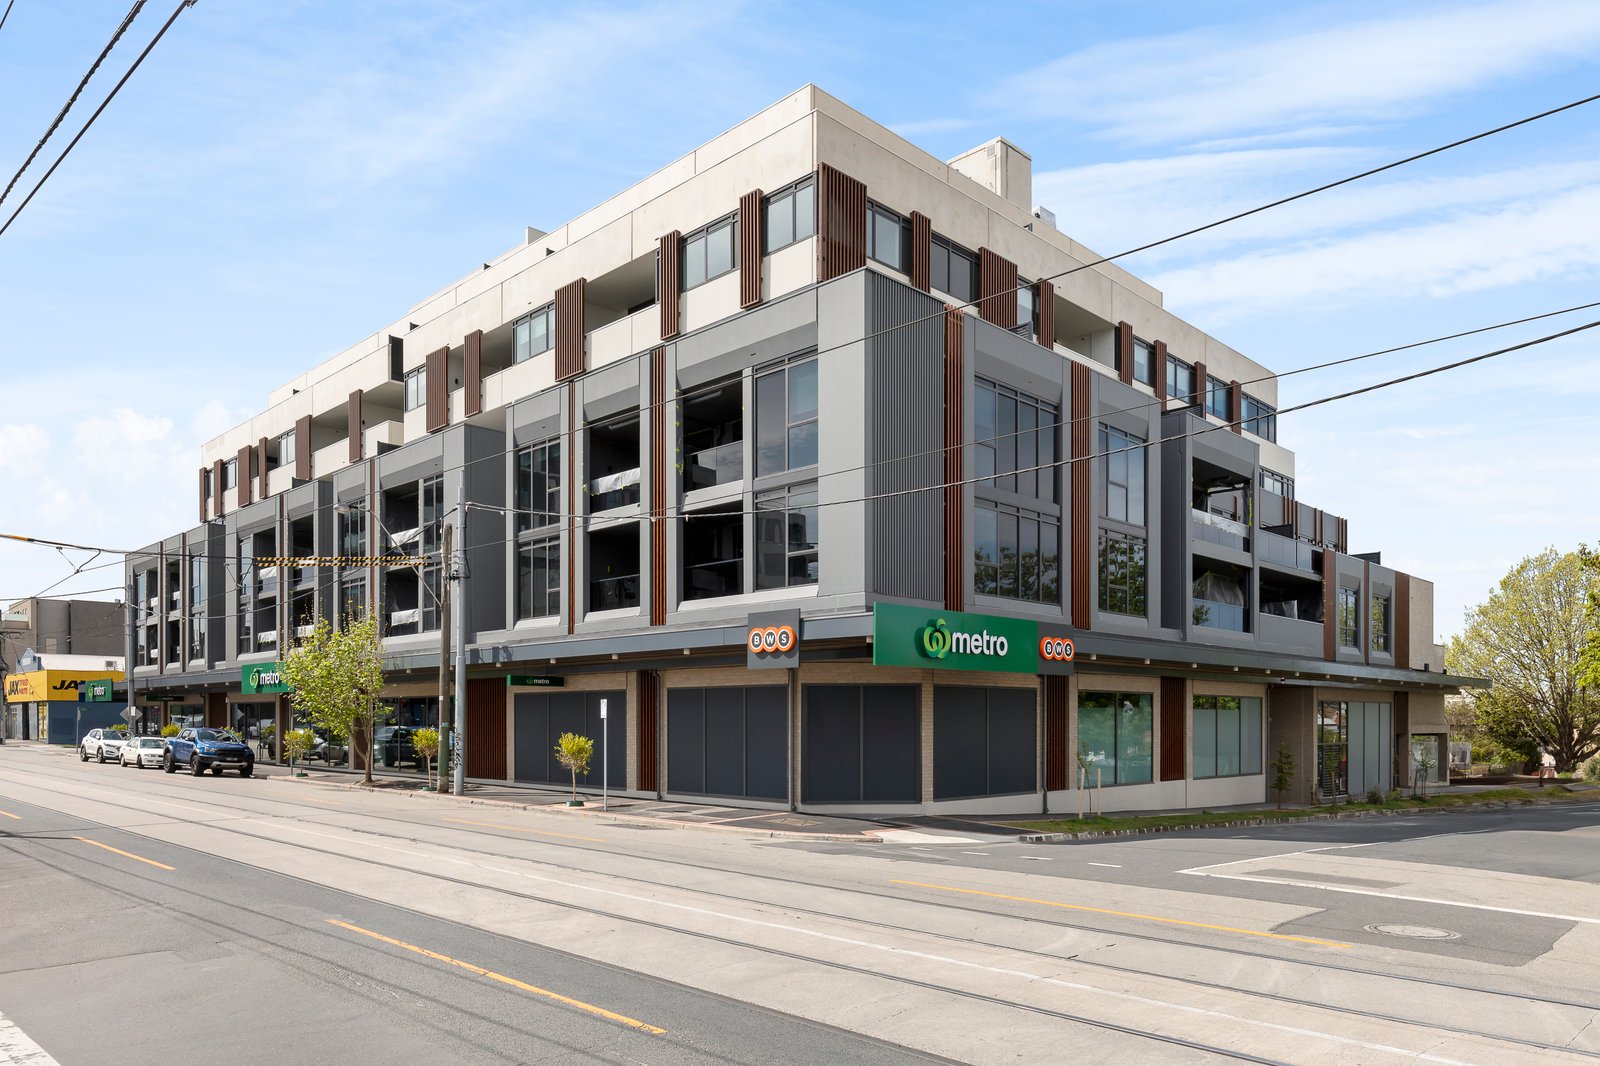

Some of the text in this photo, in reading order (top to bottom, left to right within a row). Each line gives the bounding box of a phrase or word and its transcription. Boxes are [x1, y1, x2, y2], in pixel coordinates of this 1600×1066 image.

[753, 632, 788, 646] BWS
[951, 629, 1008, 656] metro
[1045, 643, 1072, 655] BWS
[260, 670, 279, 685] metro
[8, 680, 19, 695] JAX
[52, 680, 79, 690] JA
